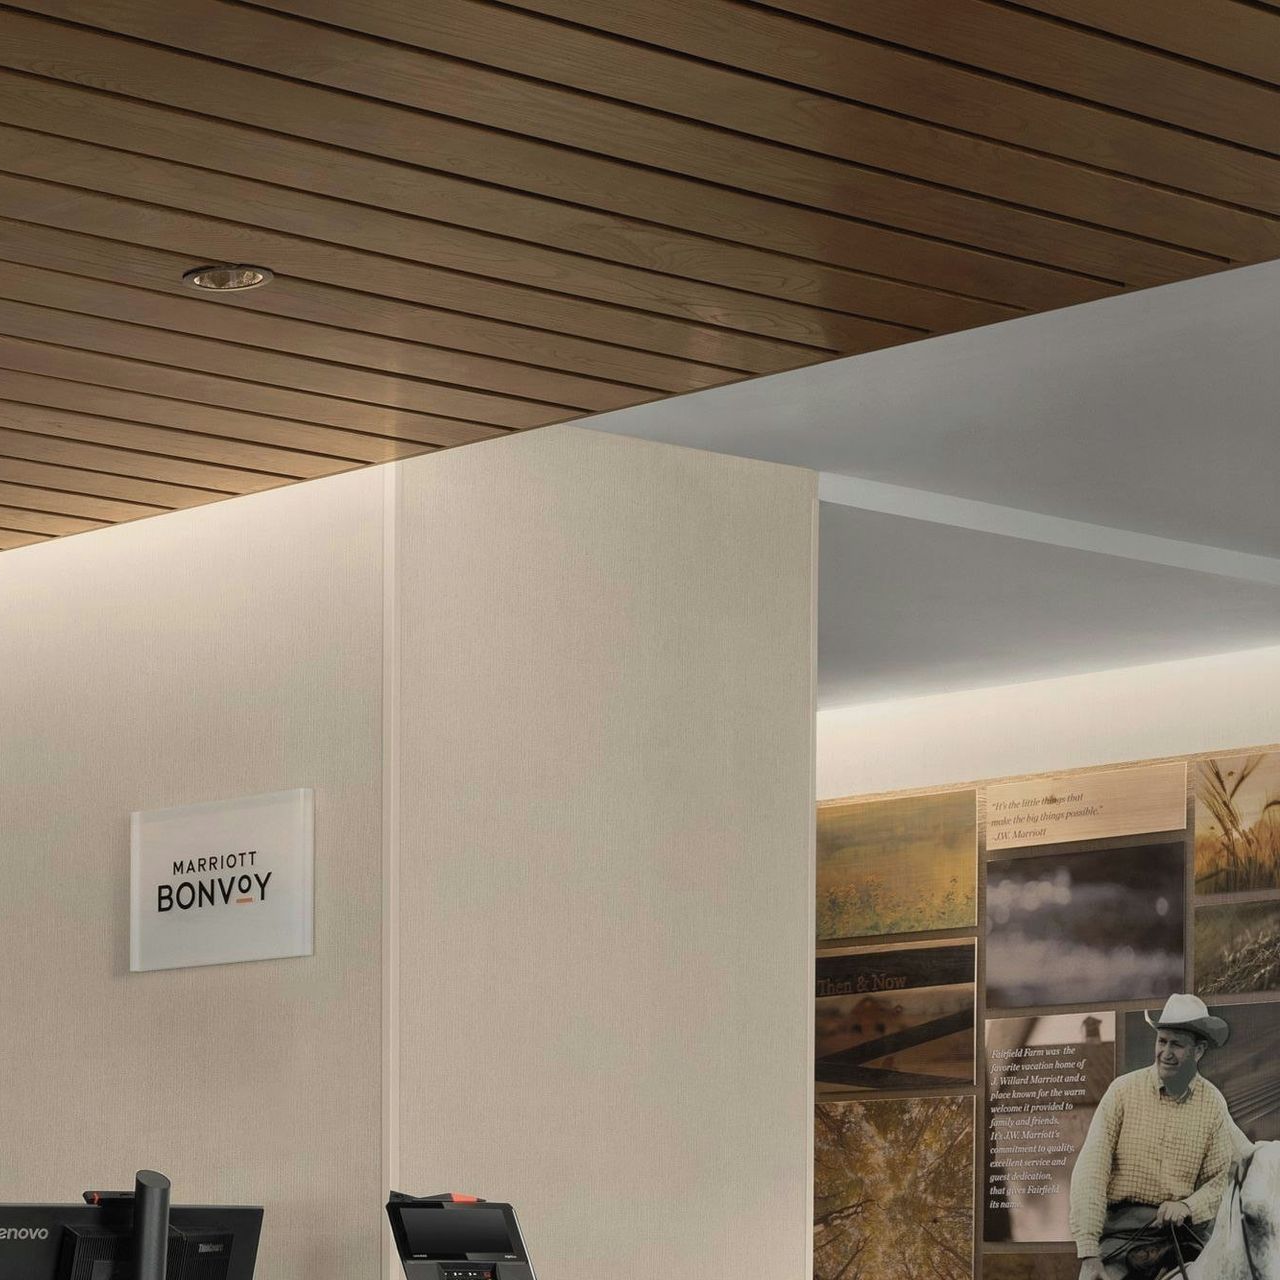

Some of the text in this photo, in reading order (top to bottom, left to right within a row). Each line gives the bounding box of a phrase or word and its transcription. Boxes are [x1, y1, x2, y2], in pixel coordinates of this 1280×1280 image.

[1008, 800, 1021, 809] the
[1022, 797, 1040, 808] little
[1041, 795, 1066, 805] things
[1067, 793, 1084, 802] that
[991, 816, 1013, 826] make
[1013, 814, 1026, 824] the
[1026, 812, 1039, 823] big
[1040, 810, 1065, 822] things
[1011, 828, 1047, 839] Marriott
[172, 850, 257, 875] MARRIOTT
[157, 871, 272, 912] BONVOY
[816, 973, 907, 995] Then & Now
[991, 1045, 1076, 1060] Fairfield Farm was the
[990, 1058, 1087, 1074] favorite vacation home of
[1000, 1075, 1029, 1085] Willard
[1030, 1075, 1064, 1084] Marriott
[1064, 1073, 1080, 1083] and
[990, 1088, 1086, 1101] place known for the warm
[990, 1102, 1074, 1113] welcome it provided to
[989, 1117, 1015, 1128] family
[1015, 1117, 1031, 1126] and
[990, 1145, 1037, 1154] commitment
[1037, 1144, 1046, 1153] to
[990, 1157, 1067, 1168] excellent service and
[989, 1173, 1010, 1183] guest
[990, 1184, 1060, 1196] that gives Fairfield
[989, 1200, 1000, 1209] its
